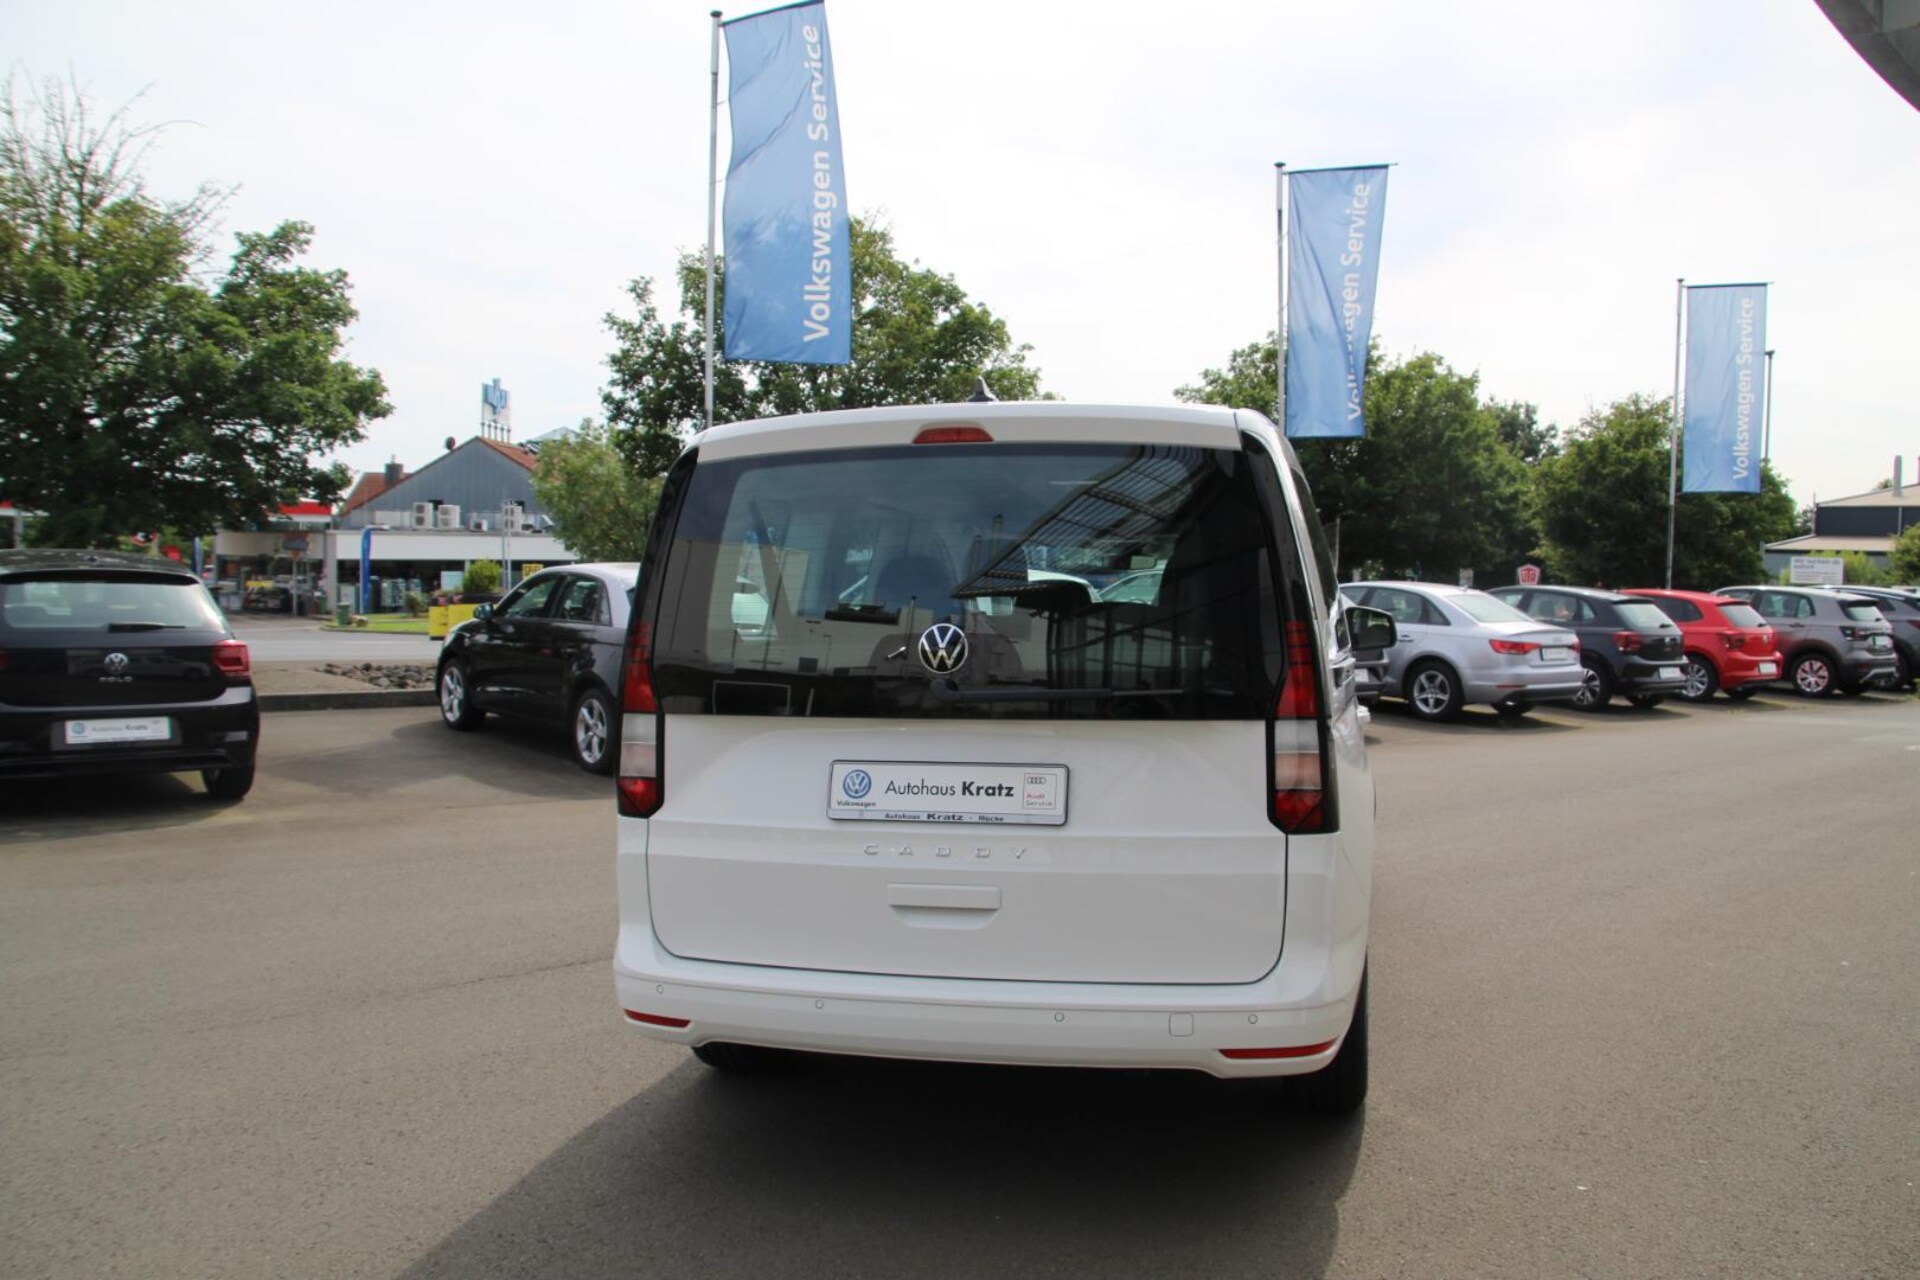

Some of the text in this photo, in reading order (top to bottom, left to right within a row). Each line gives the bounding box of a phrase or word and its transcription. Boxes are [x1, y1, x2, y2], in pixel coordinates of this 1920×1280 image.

[803, 24, 838, 342] Volkswagen Service
[1340, 183, 1370, 266] Service
[1732, 298, 1755, 479] Volkswagen Service
[885, 778, 1015, 797] Autohaus Kratz
[837, 800, 877, 808] Volkswagen
[884, 812, 921, 820] Autohaus
[926, 812, 963, 821] Kratz
[863, 843, 1028, 860] CADDY
